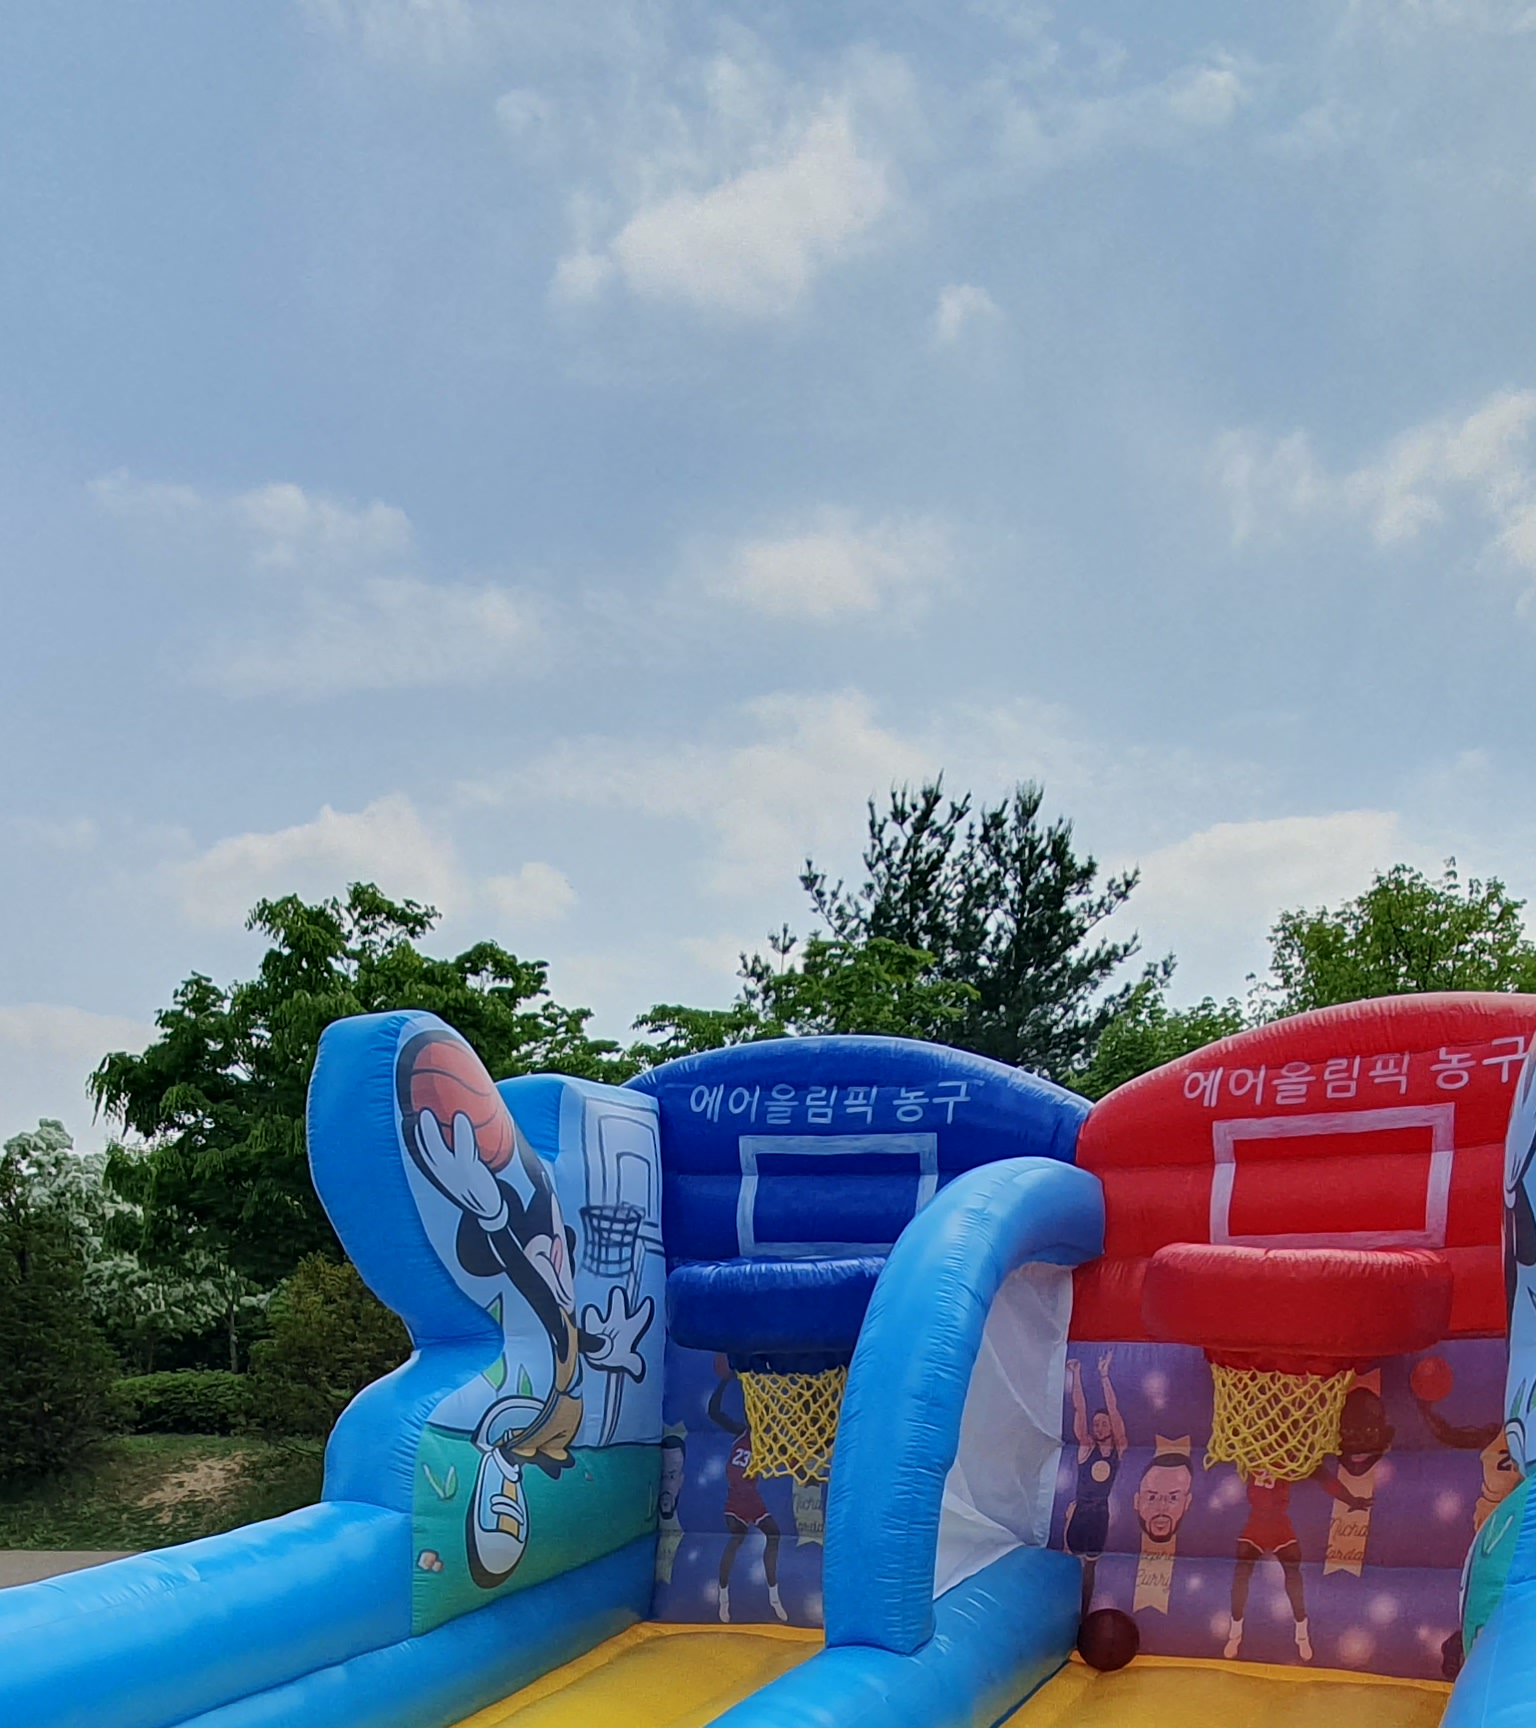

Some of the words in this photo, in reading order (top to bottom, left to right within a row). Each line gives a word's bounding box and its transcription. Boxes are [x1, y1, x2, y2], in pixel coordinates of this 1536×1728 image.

[1183, 1050, 1410, 1107] 에어올림픽
[1430, 1035, 1530, 1091] 농구
[690, 1083, 877, 1125] 에어올림픽
[892, 1080, 971, 1125] 농구
